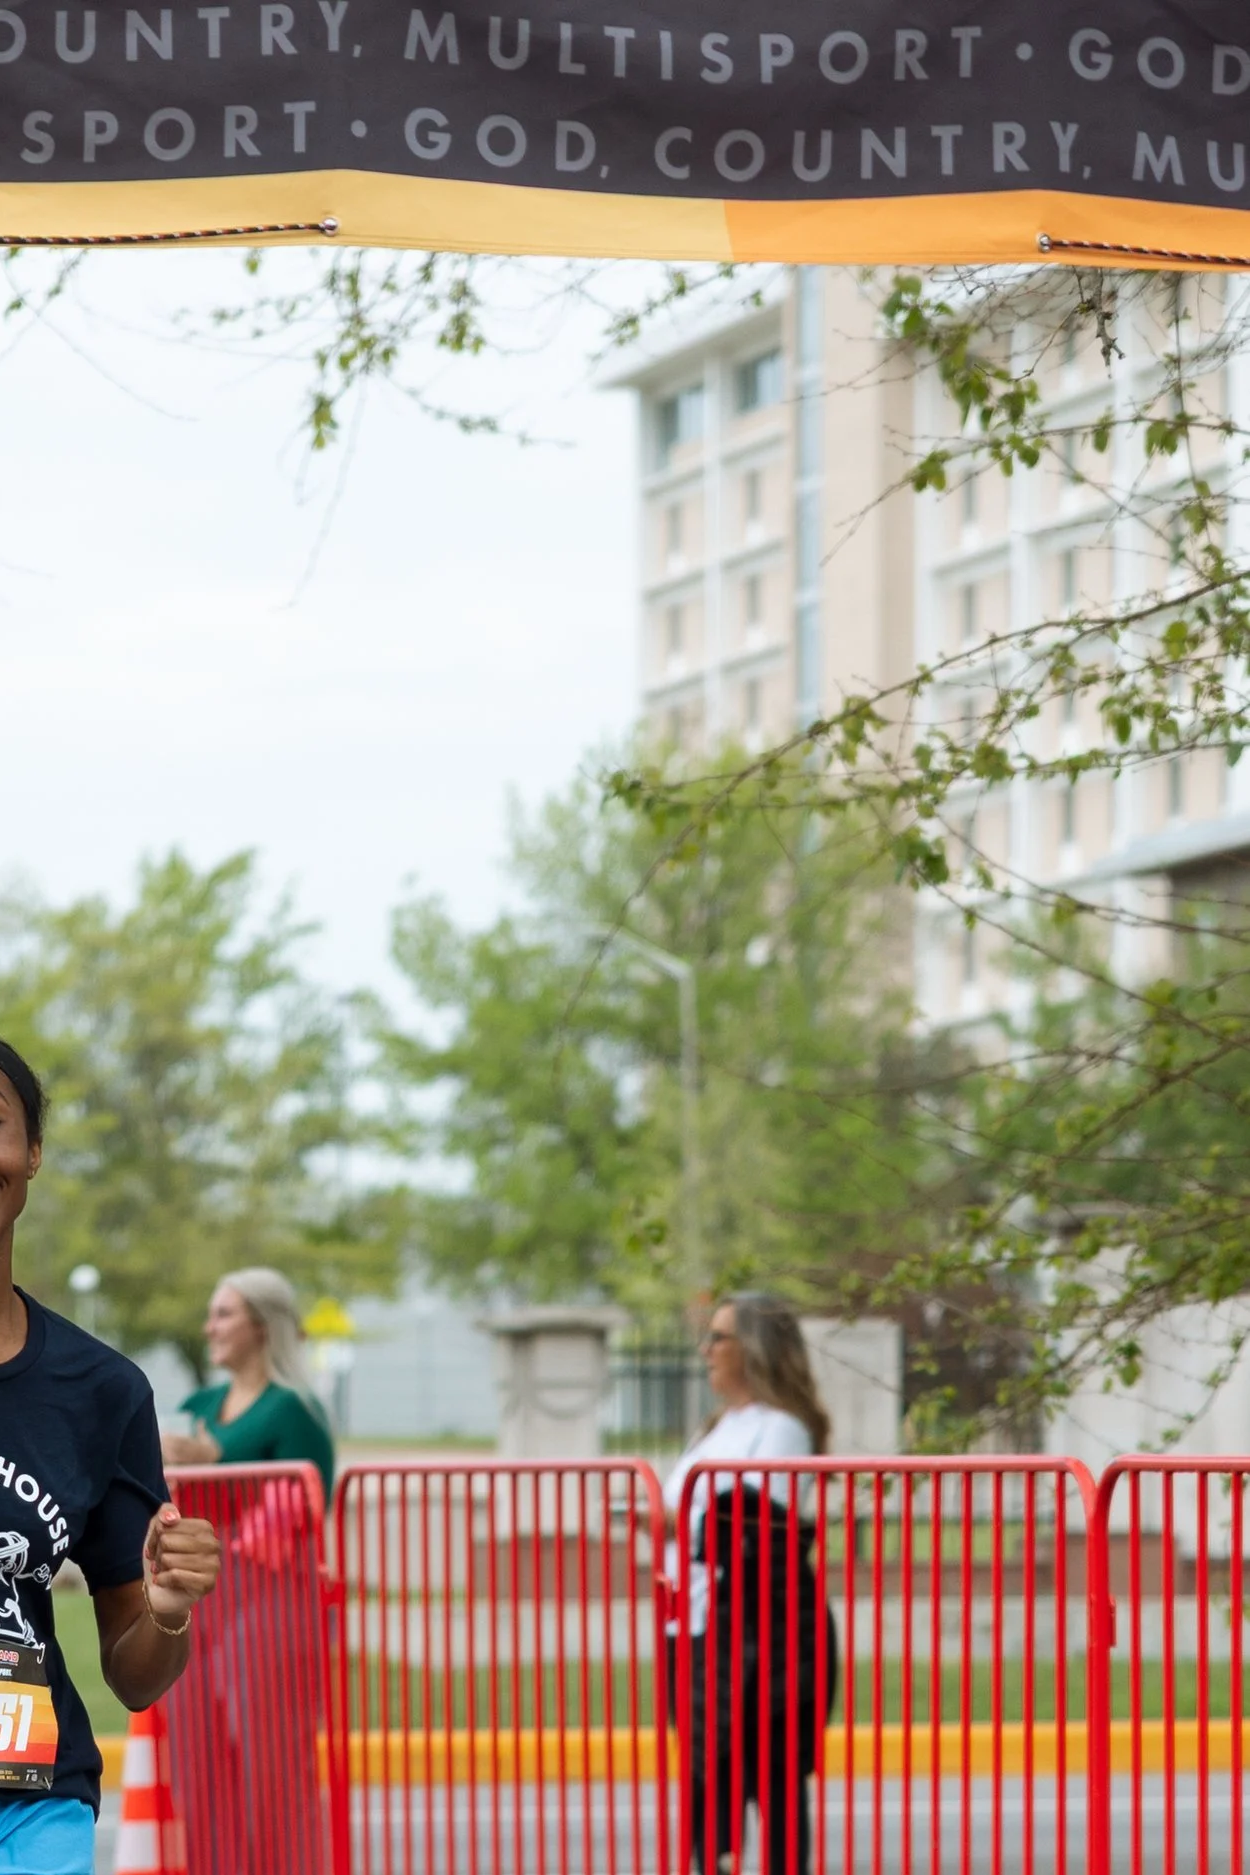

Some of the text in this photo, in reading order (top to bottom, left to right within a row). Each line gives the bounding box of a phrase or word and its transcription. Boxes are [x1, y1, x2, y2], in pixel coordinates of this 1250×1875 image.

[404, 10, 982, 84] MULTISPORT
[1069, 29, 1250, 95] GOD
[404, 108, 609, 179] GOD,
[654, 121, 1091, 183] COUNTRY,
[1132, 131, 1246, 192] MU
